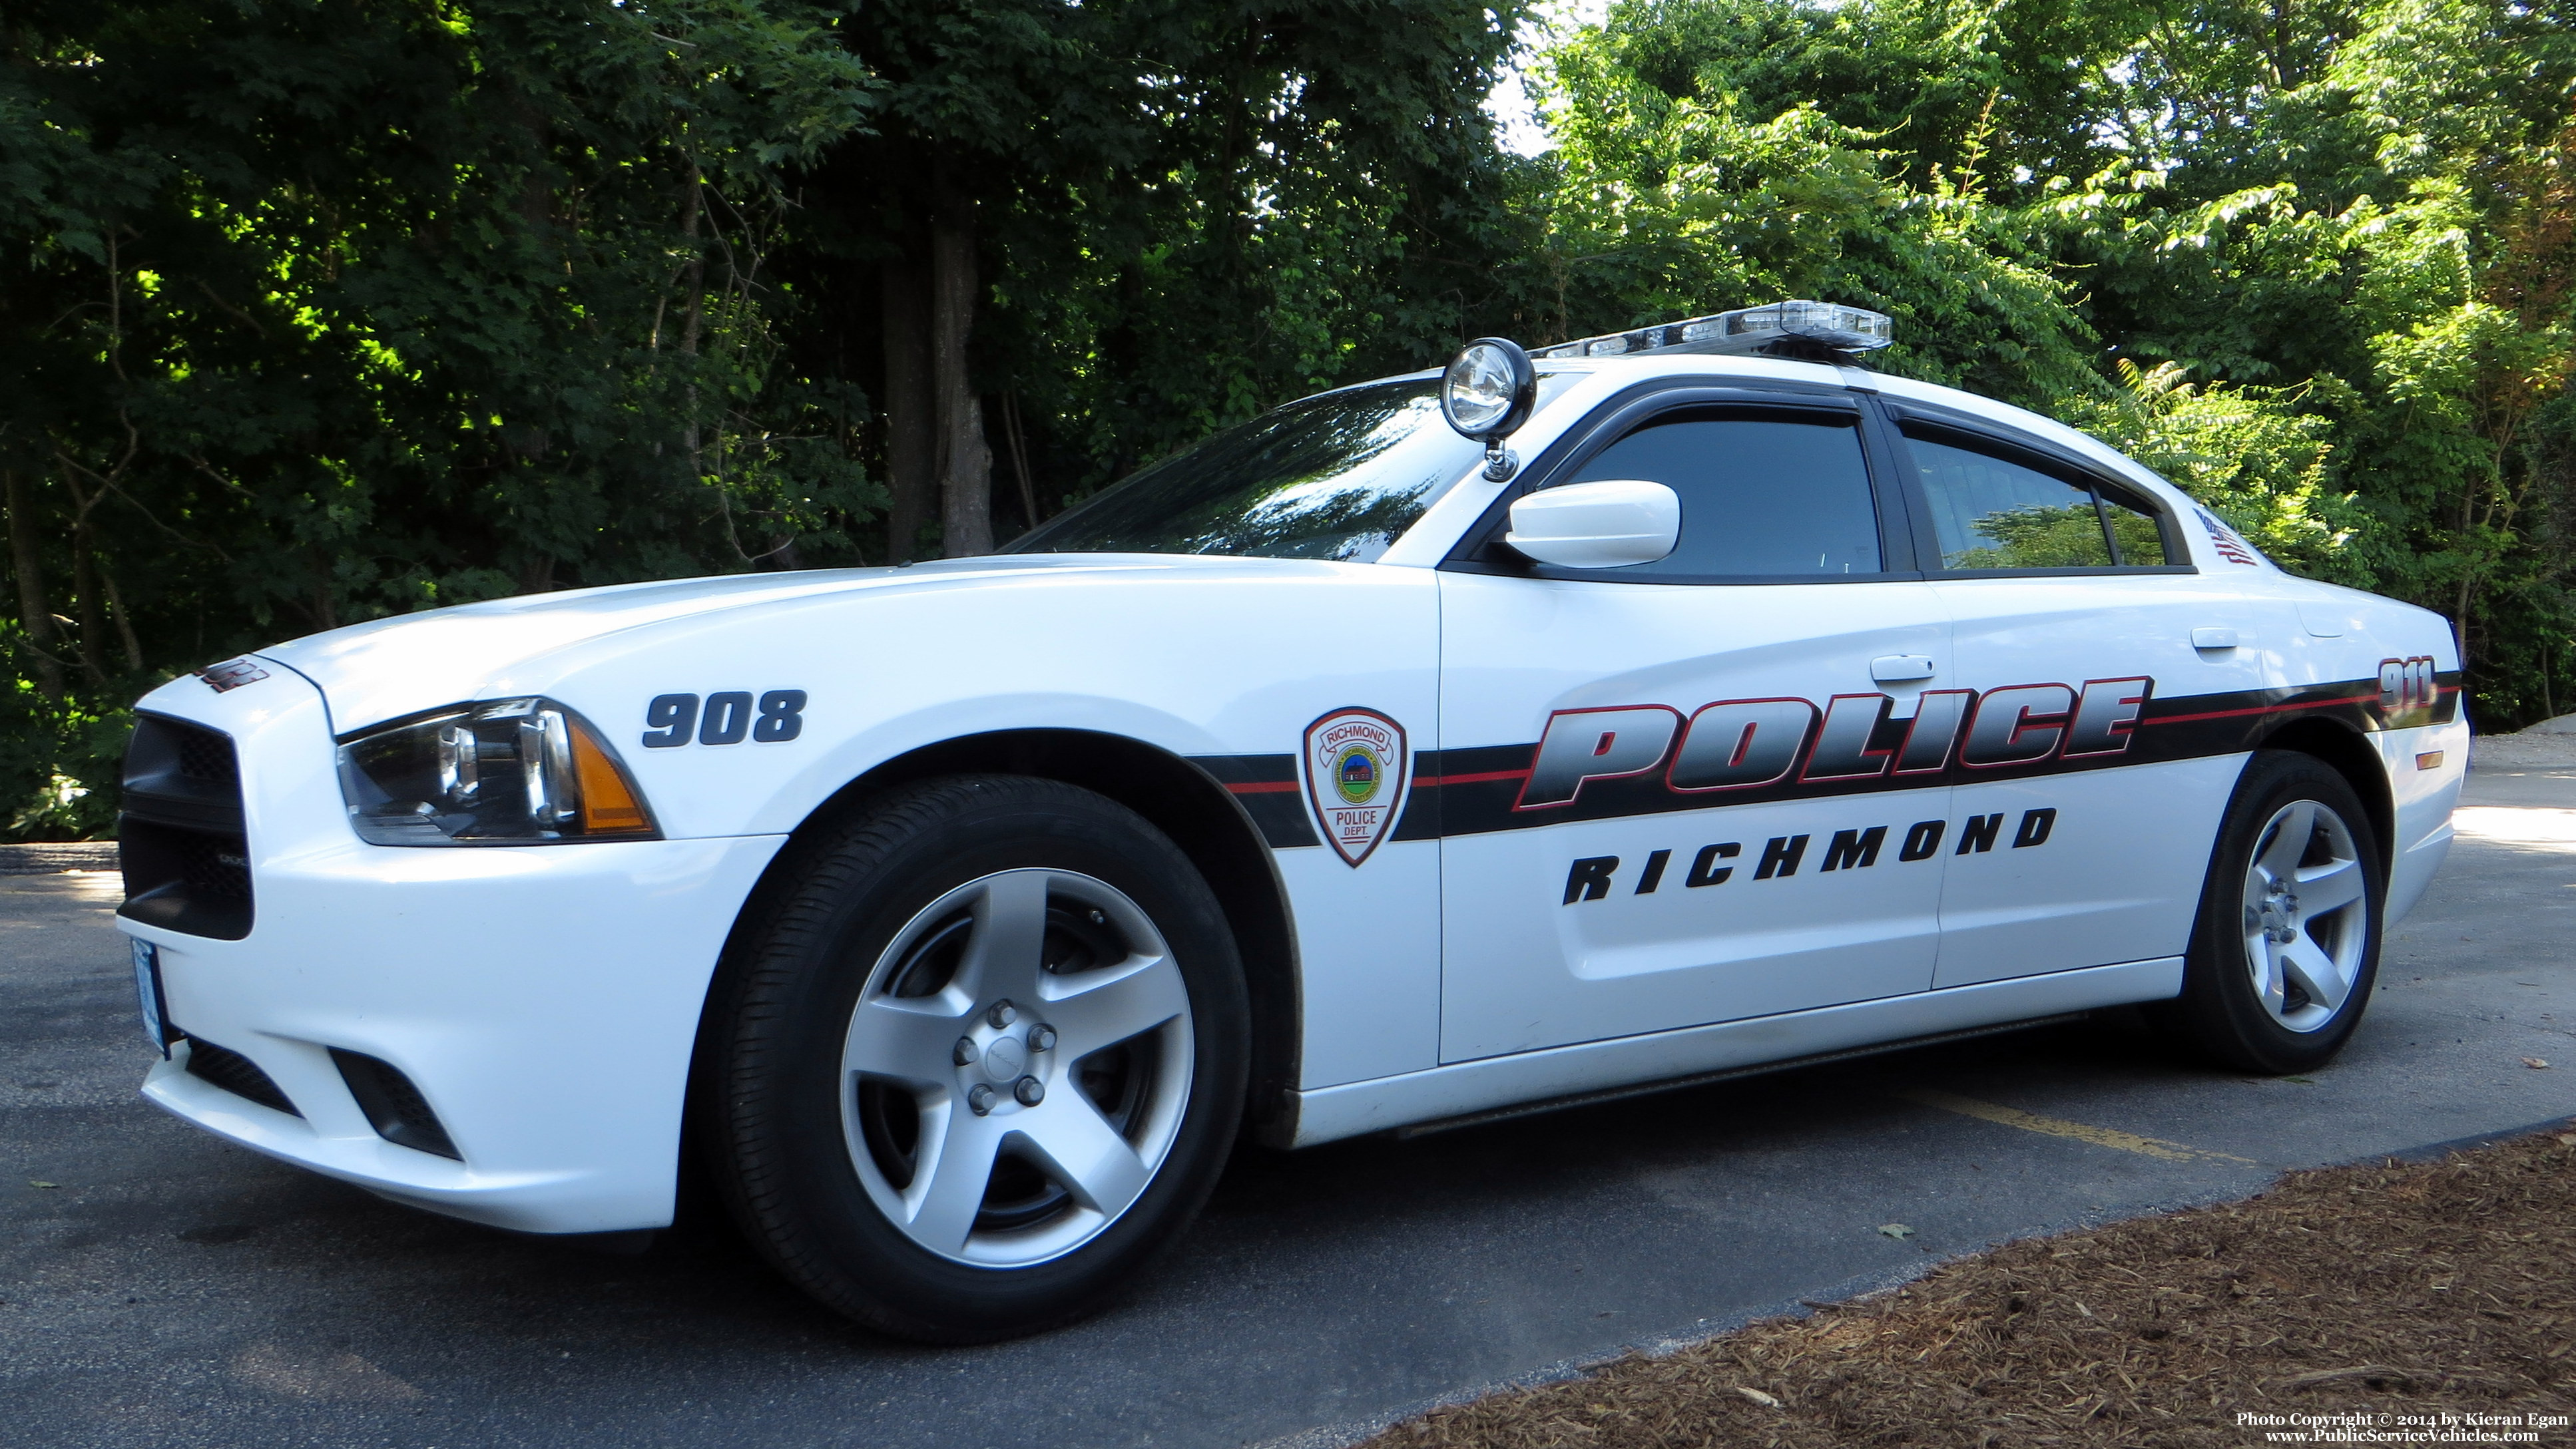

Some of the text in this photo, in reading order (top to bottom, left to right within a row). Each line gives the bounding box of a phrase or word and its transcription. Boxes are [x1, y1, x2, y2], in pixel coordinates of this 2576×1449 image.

[2378, 655, 2436, 711] 911
[642, 689, 808, 748] 908
[1326, 725, 1386, 745] RICHMOND
[1511, 675, 2155, 812] POLICE
[1336, 810, 1376, 825] POLICE
[1344, 826, 1368, 836] DEPT.
[1562, 807, 2058, 907] RICHMOND
